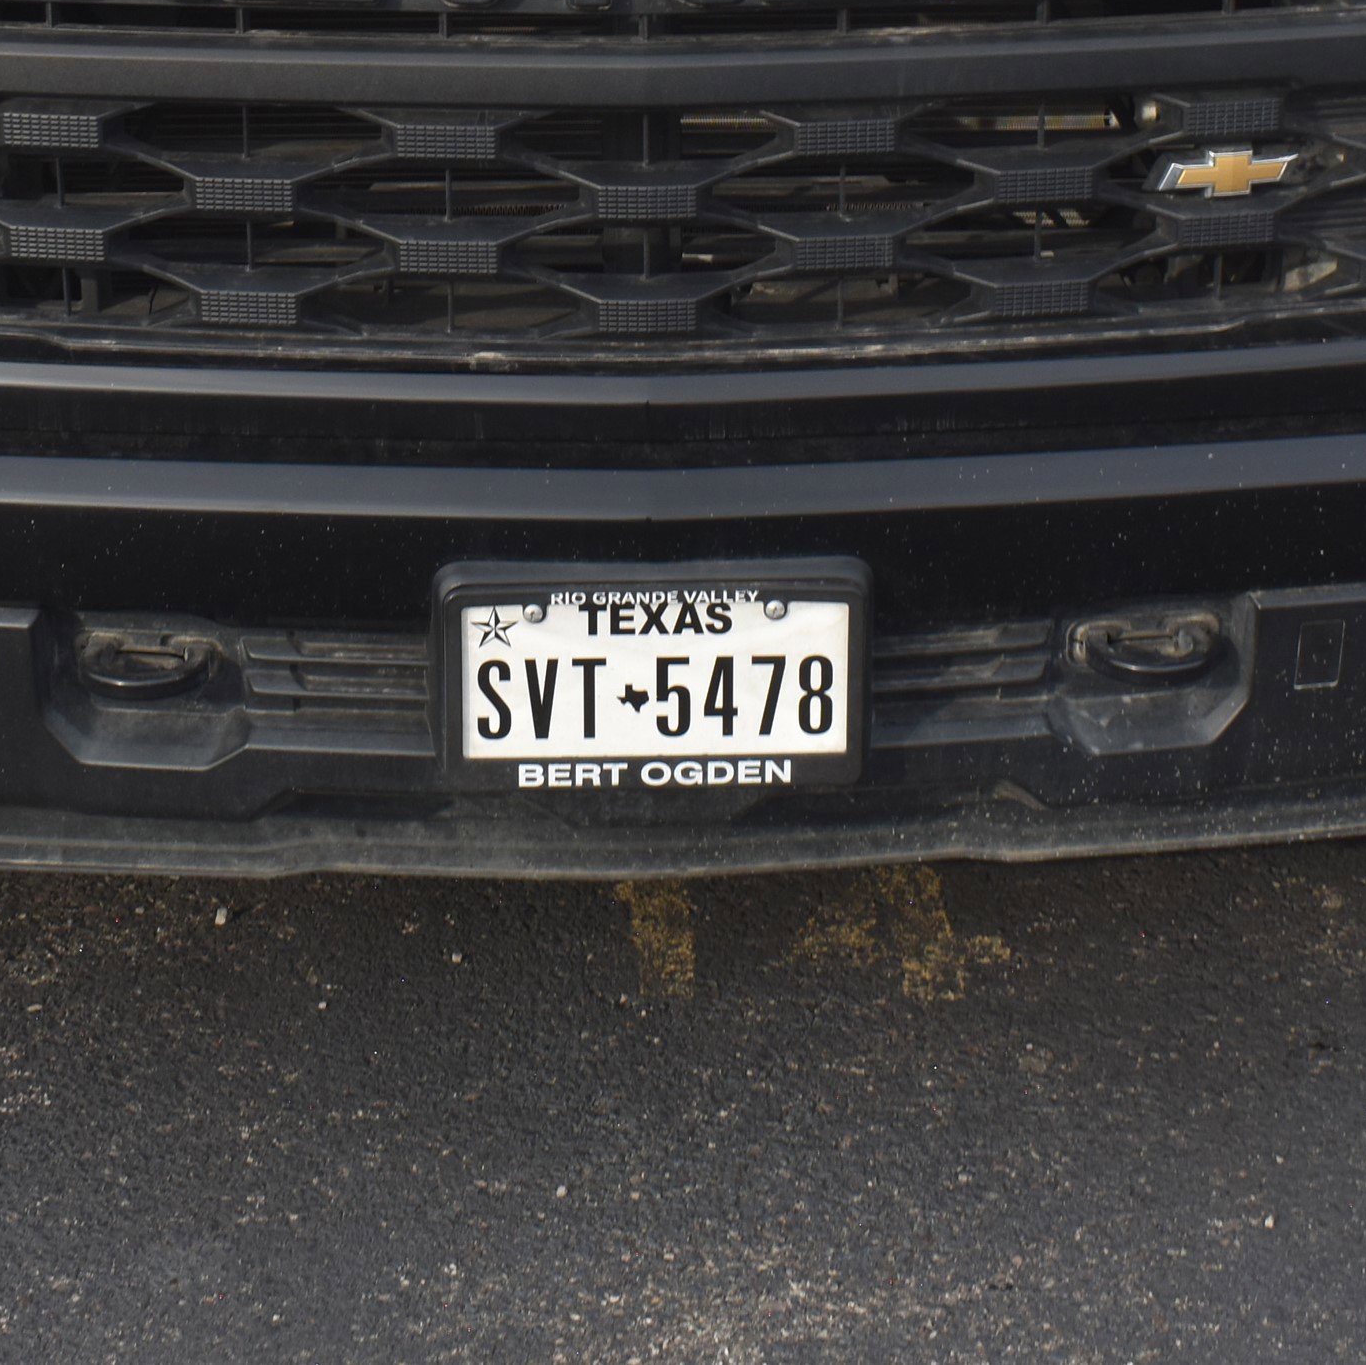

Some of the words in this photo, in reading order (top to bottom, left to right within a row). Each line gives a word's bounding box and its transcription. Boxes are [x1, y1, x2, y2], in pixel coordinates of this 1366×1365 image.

[550, 592, 586, 605] RIO
[591, 591, 679, 605] GRANDE
[682, 589, 760, 604] VALLEY
[578, 602, 733, 636] TEXAS
[476, 657, 607, 740] SVT
[656, 654, 834, 738] 5478
[518, 762, 628, 788] BERT
[640, 759, 792, 786] OGDEN
